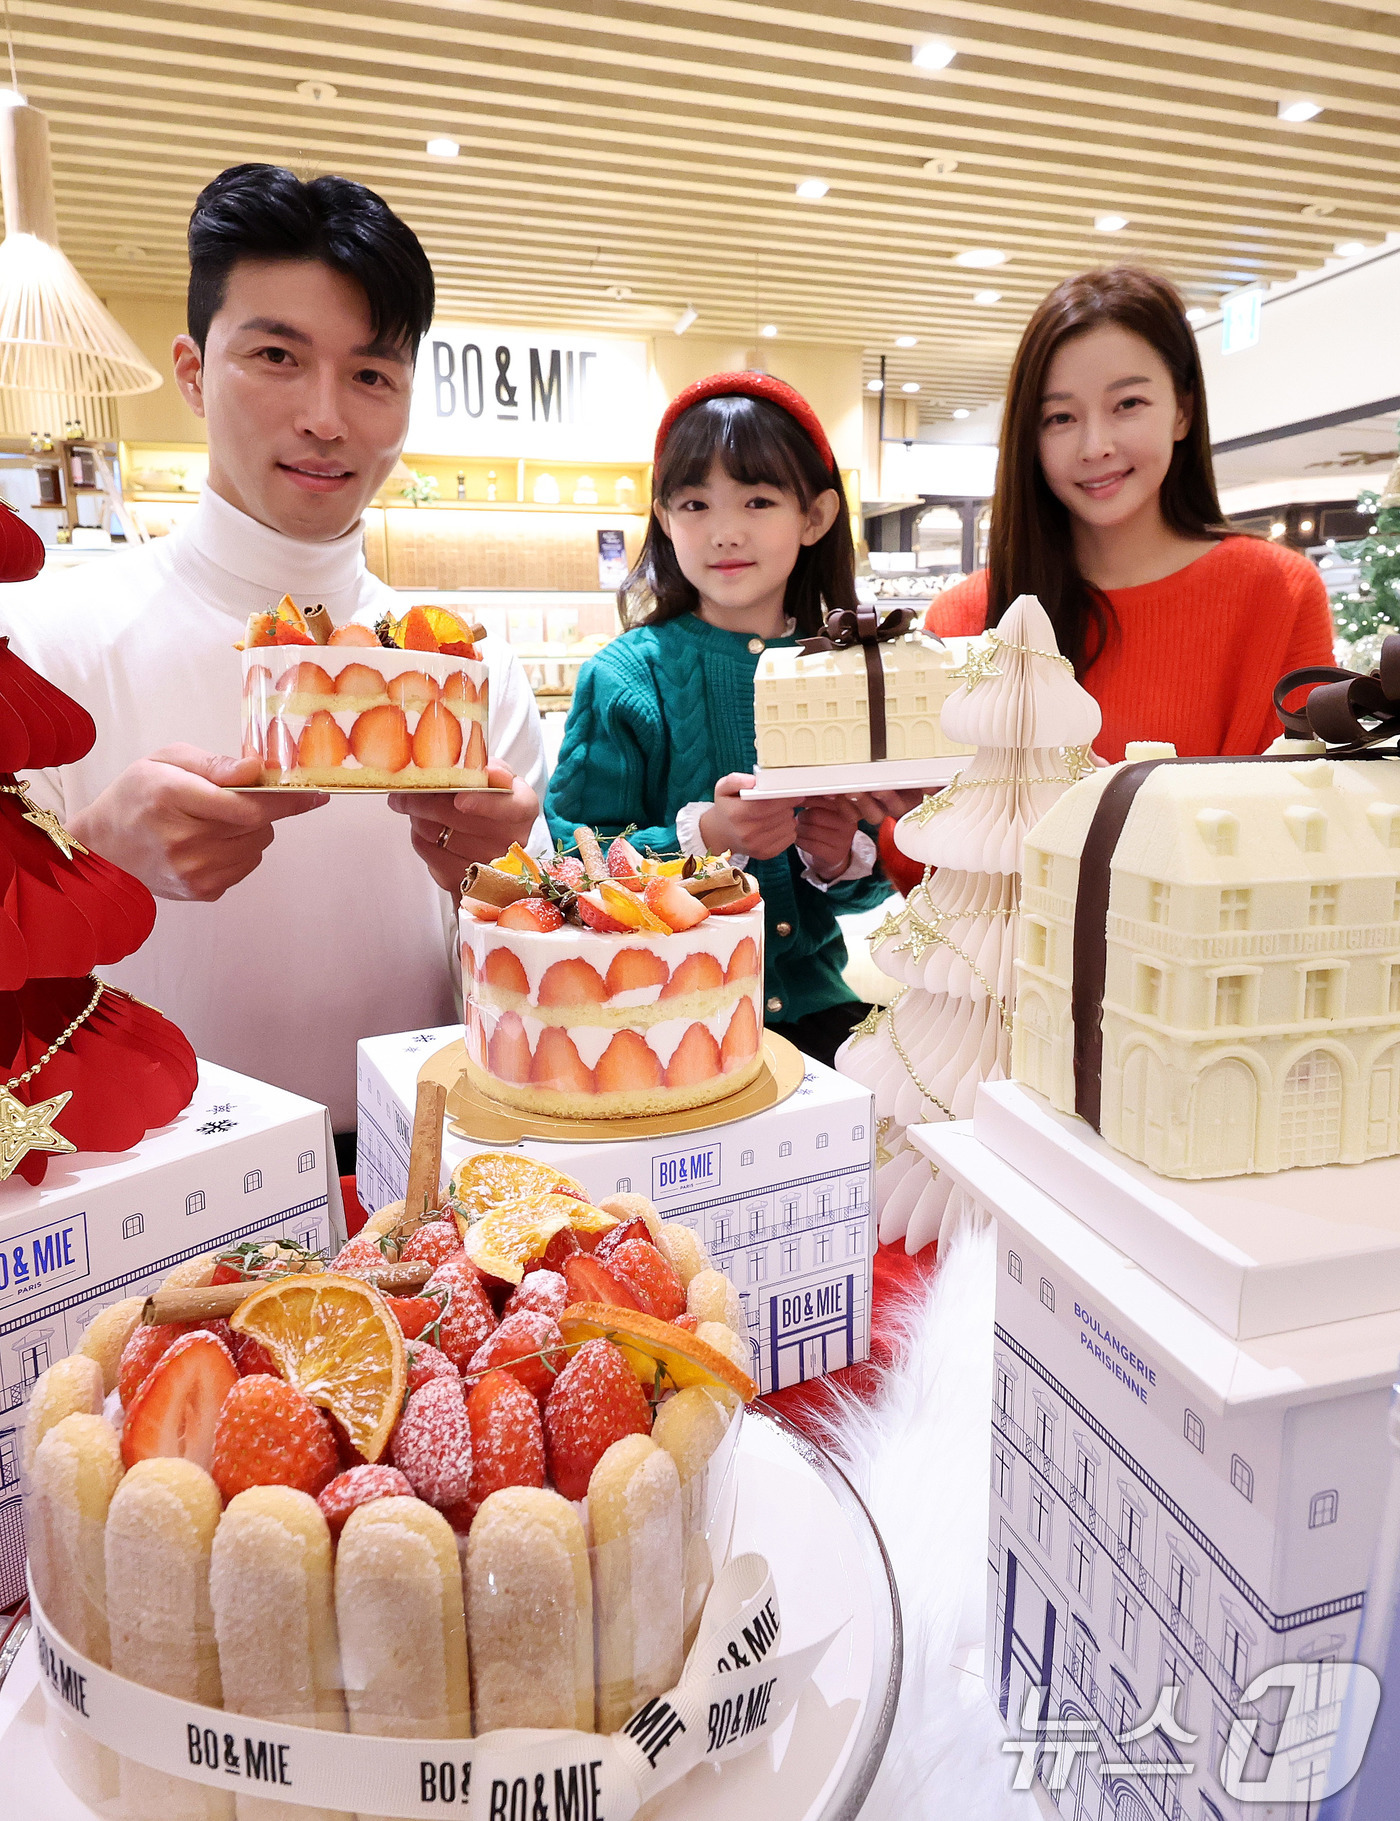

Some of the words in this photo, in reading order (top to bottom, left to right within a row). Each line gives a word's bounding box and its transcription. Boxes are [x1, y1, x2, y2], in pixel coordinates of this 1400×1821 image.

[17, 1281, 42, 1296] PARIS
[1074, 1301, 1157, 1388] BOULANGERIE
[1080, 1331, 1148, 1406] PARISIENNE
